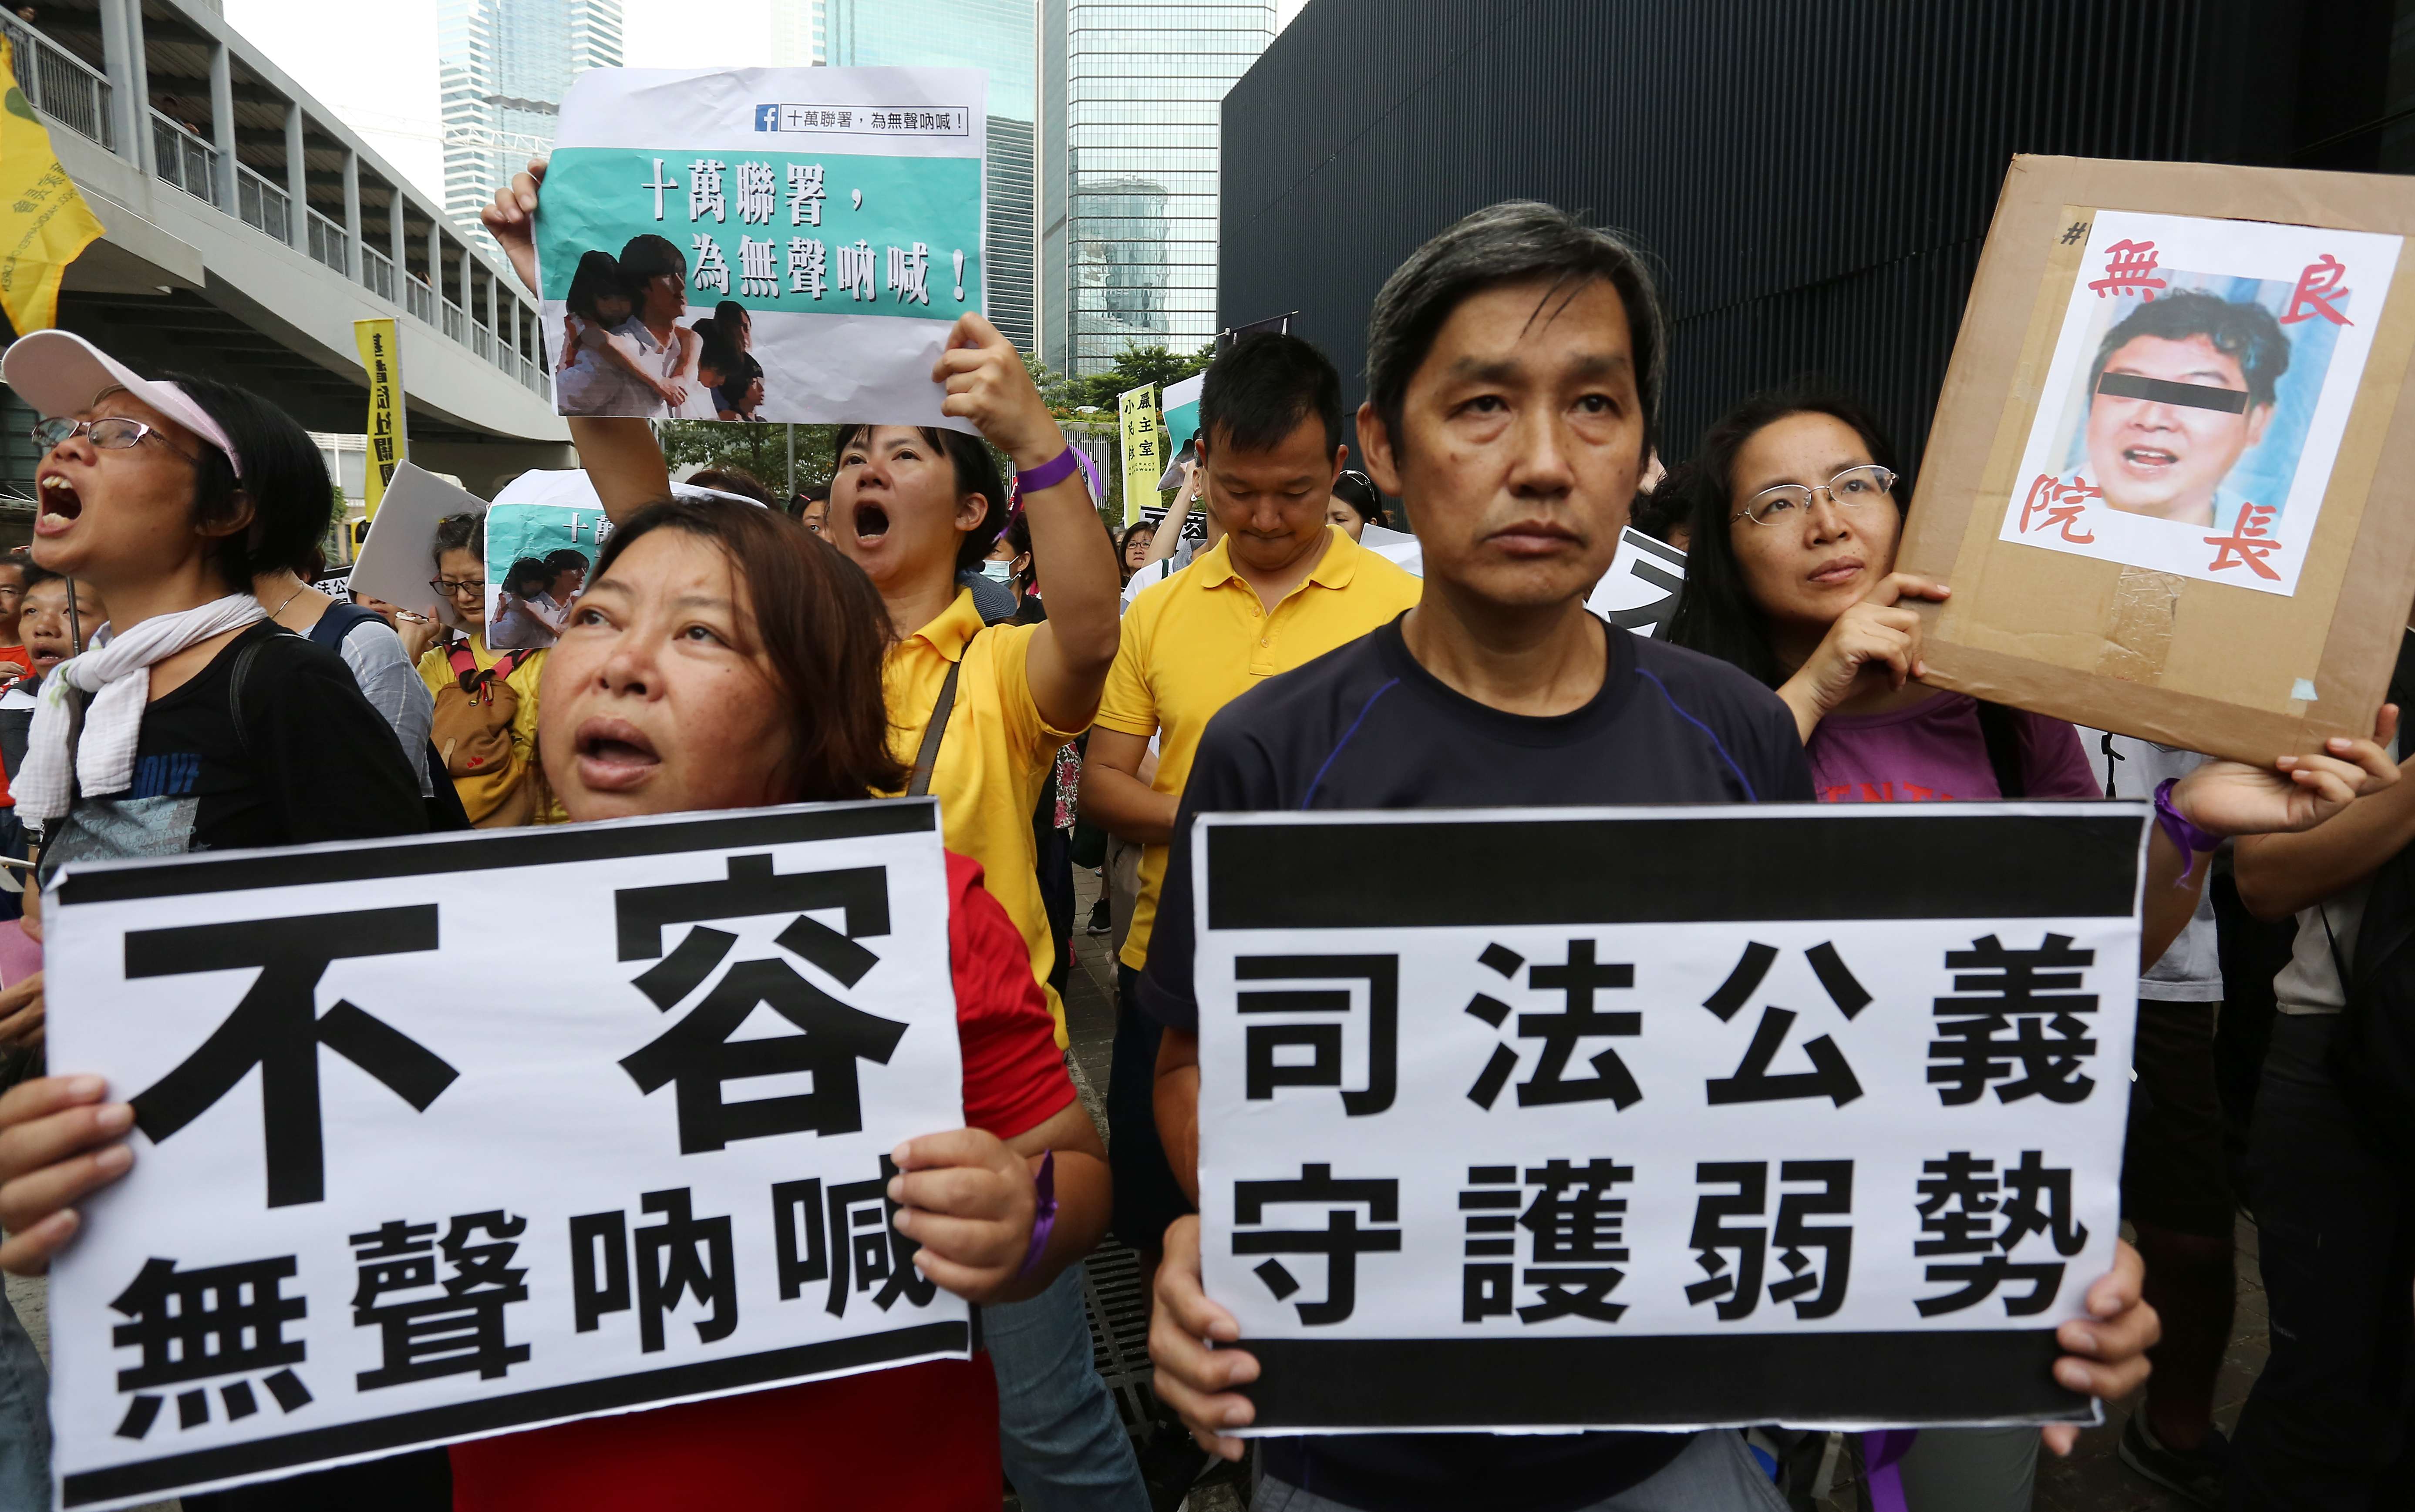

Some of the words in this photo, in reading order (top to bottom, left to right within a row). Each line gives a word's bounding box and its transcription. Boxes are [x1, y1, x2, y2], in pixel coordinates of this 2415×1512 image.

[125, 853, 909, 1208] 不容
[1234, 933, 2099, 1117] 司法公義
[110, 1153, 938, 1439] 無聲吶喊
[1232, 1150, 2089, 1326] 守護弱勢
